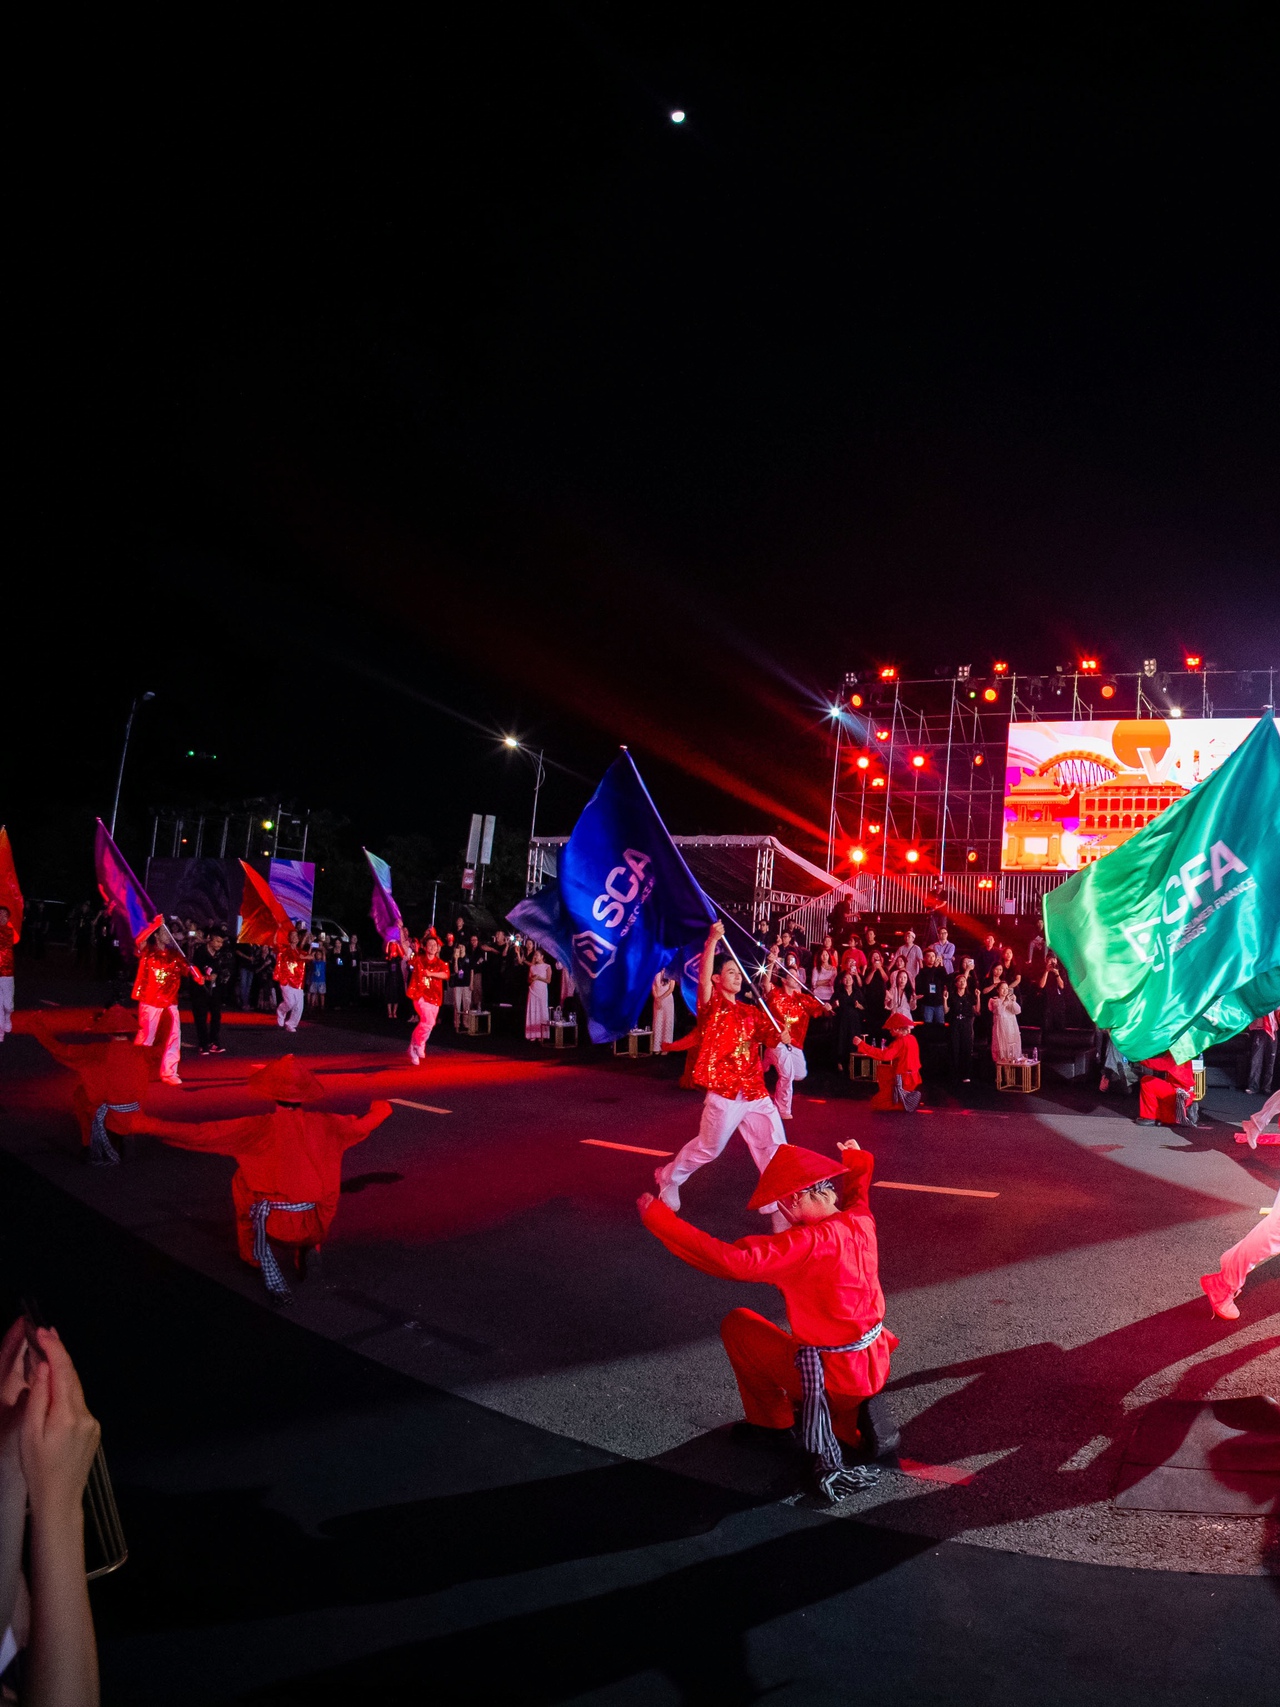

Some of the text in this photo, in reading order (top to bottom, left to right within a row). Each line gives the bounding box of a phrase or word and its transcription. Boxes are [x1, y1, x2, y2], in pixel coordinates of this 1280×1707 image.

[592, 848, 651, 928] SCA
[1162, 840, 1248, 925] CFA
[1213, 876, 1257, 909] FINANCE
